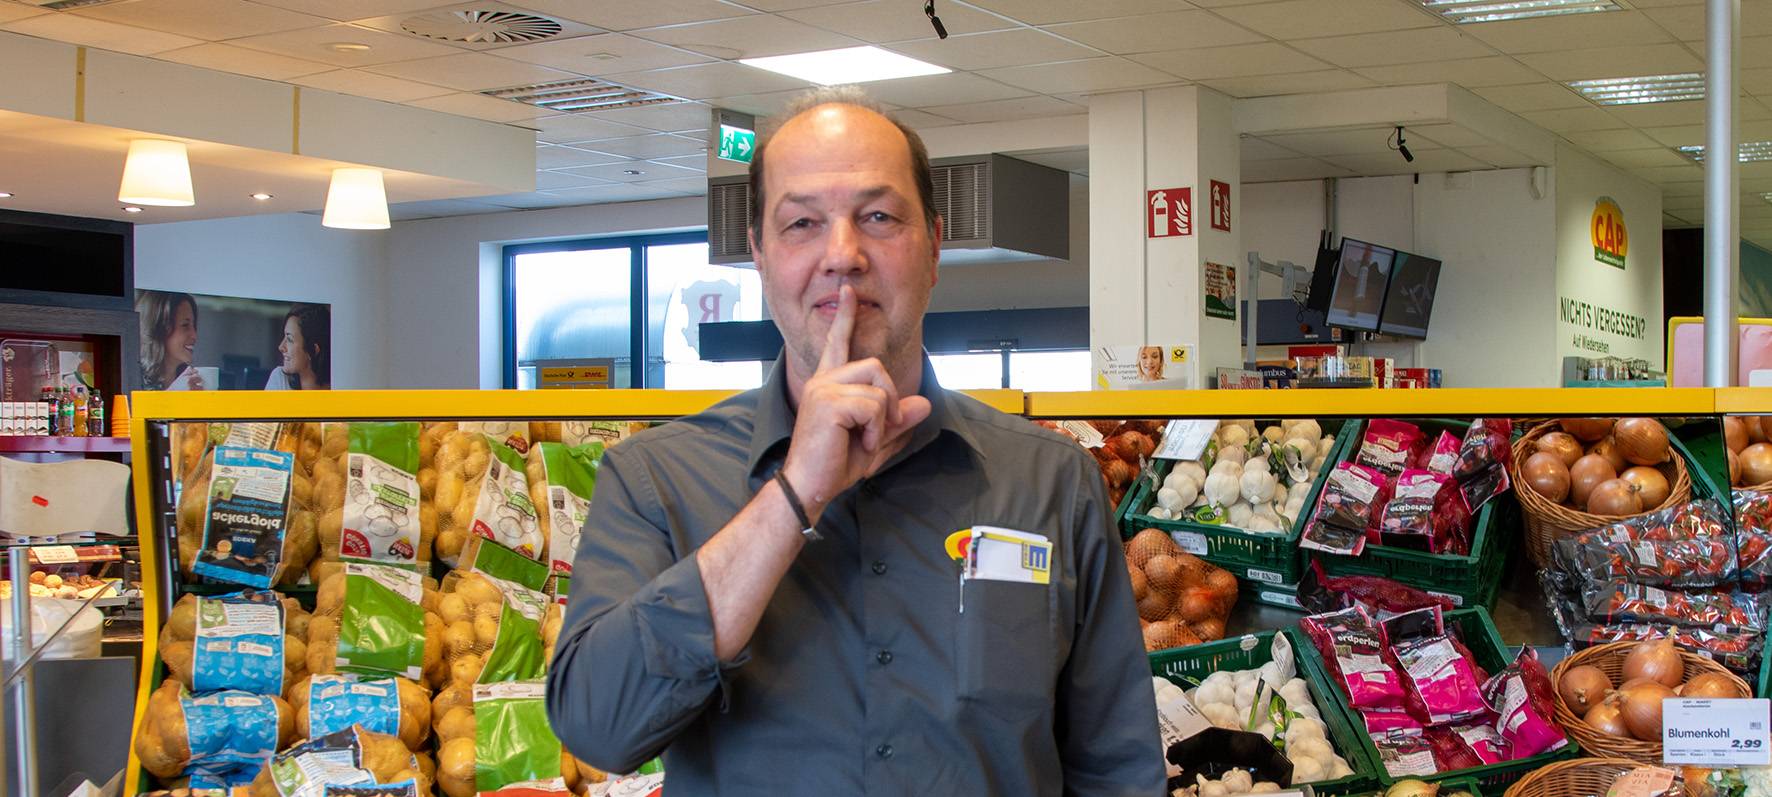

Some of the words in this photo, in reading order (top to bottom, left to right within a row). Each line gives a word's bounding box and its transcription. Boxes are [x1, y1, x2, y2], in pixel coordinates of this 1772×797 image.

[1595, 213, 1624, 257] CAP
[1560, 297, 1592, 328] NICHTS
[1593, 305, 1646, 340] VERGESSEN?
[1572, 334, 1581, 349] Auf
[1582, 335, 1610, 354] Wiedersehen
[1337, 634, 1380, 649] erdperlen
[1668, 728, 1730, 739] Blumenkohl
[1731, 739, 1762, 749] 2,99
